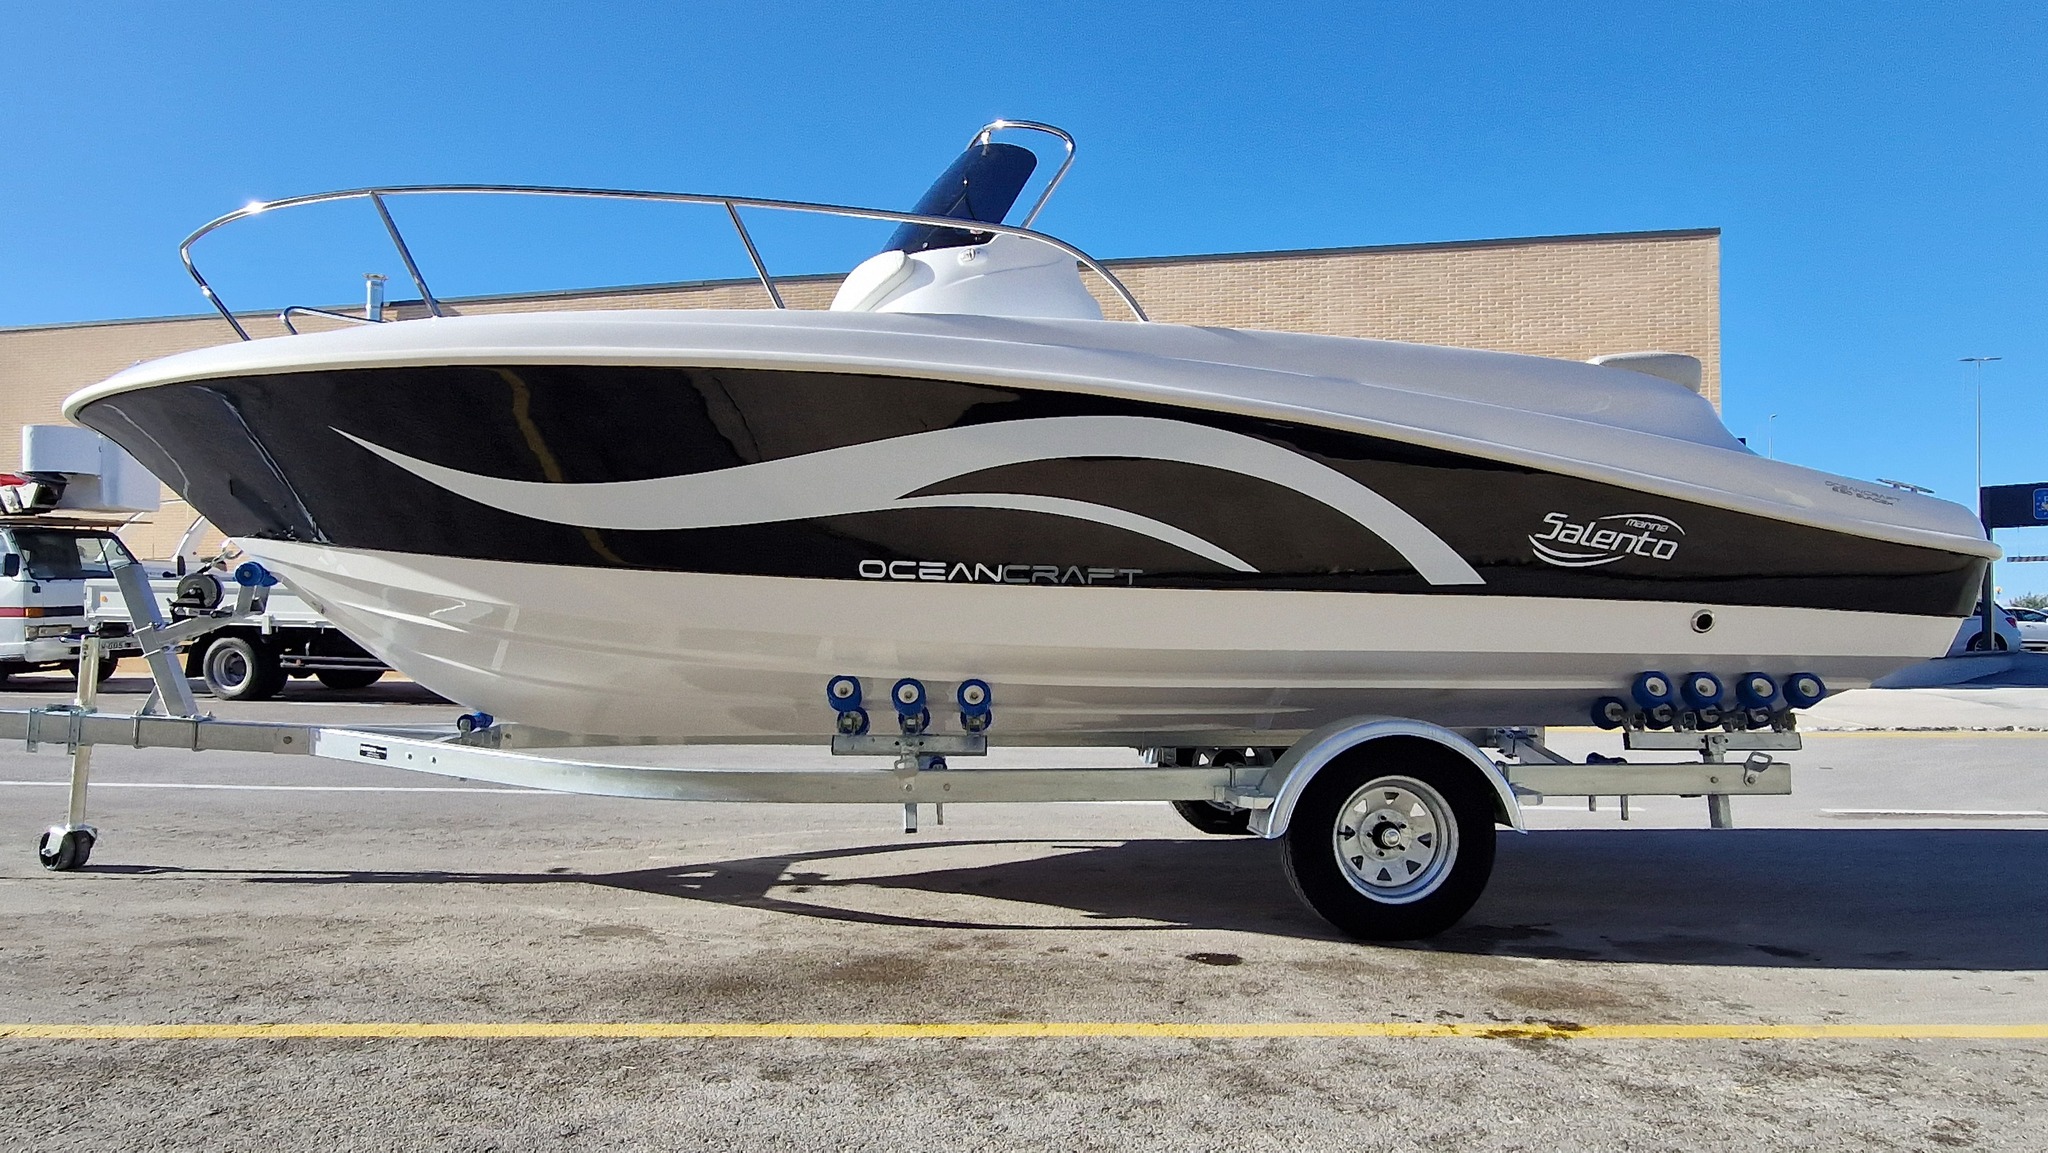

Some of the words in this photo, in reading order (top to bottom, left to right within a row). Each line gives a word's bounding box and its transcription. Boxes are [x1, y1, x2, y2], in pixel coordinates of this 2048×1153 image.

[1533, 511, 1679, 561] Salento
[1625, 518, 1670, 533] marine
[858, 559, 1144, 585] OCEANCRAFT
